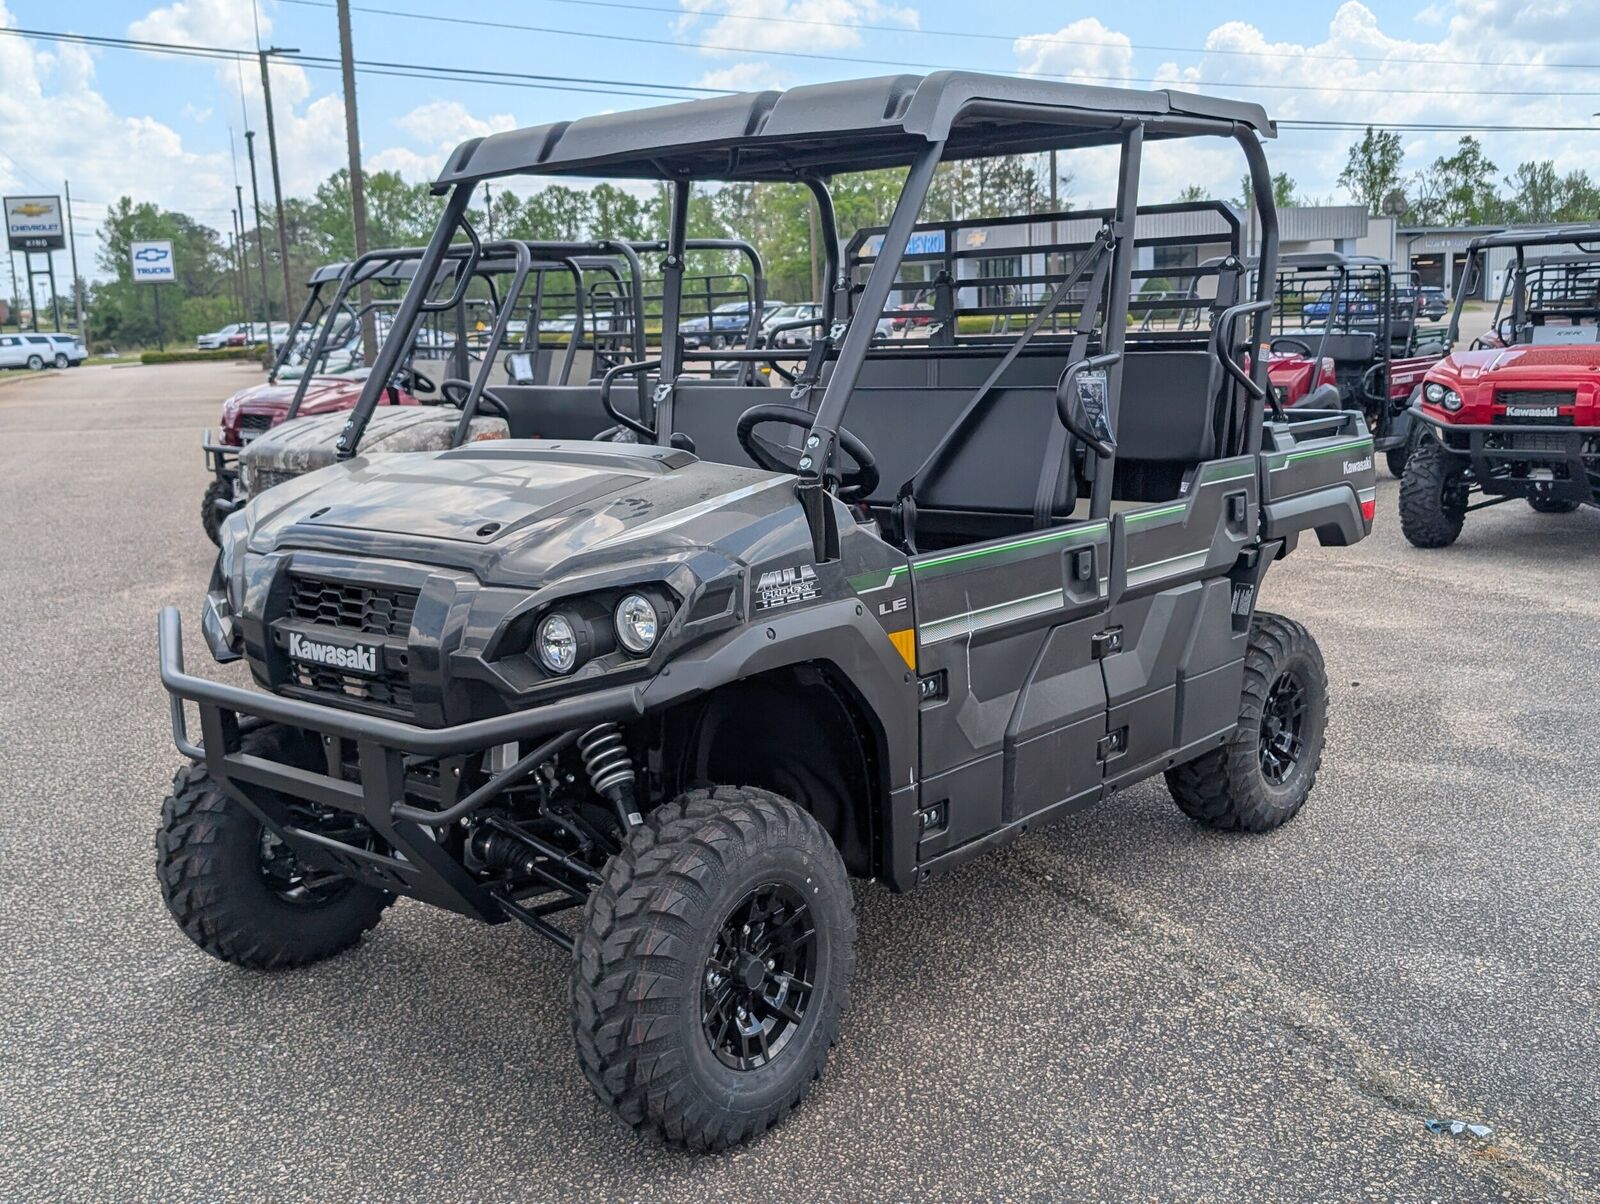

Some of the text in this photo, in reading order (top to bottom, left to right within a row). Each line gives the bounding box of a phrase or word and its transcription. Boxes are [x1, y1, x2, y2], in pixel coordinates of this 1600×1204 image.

[11, 224, 58, 232] CHEVROLET
[1506, 406, 1558, 417] Kawasaki
[1343, 455, 1372, 475] Kawasaki
[878, 597, 908, 616] LE
[289, 632, 376, 672] Kawasaki
